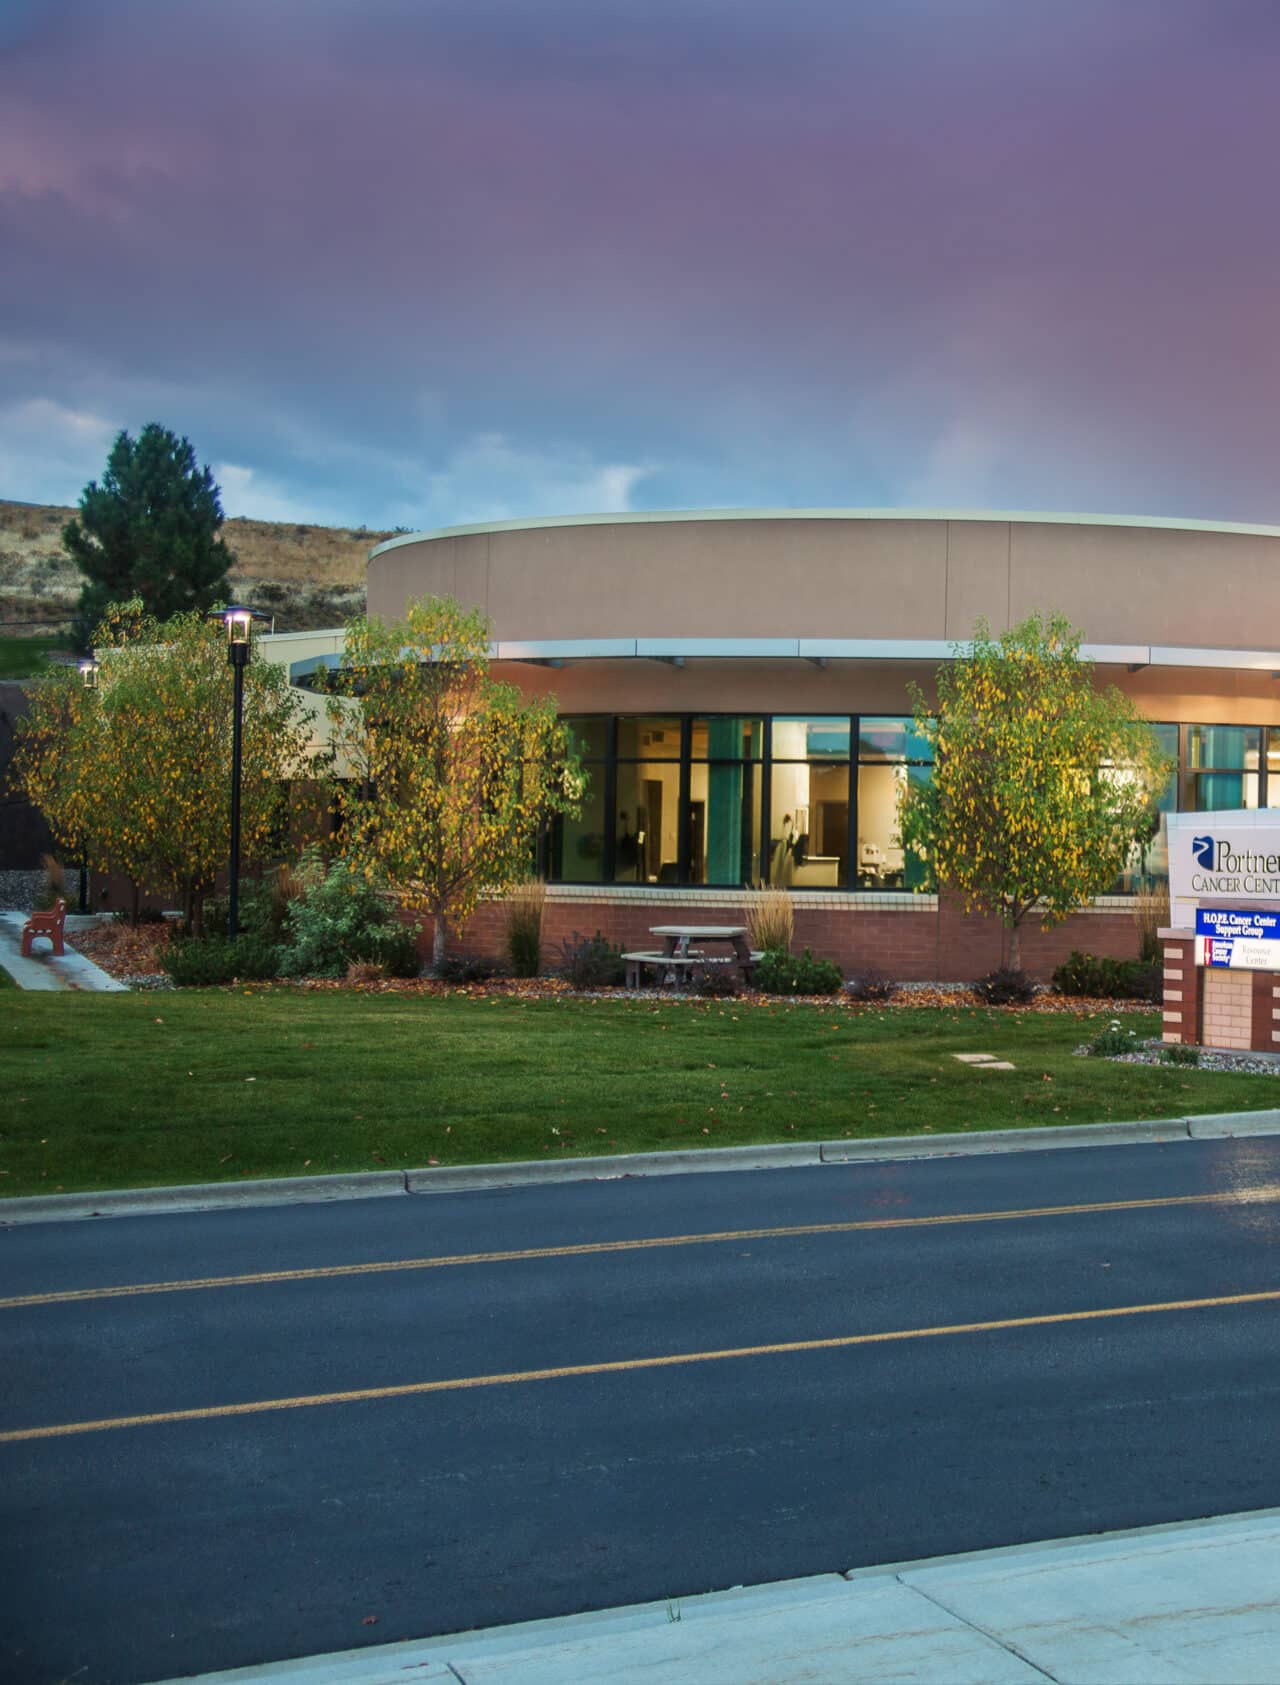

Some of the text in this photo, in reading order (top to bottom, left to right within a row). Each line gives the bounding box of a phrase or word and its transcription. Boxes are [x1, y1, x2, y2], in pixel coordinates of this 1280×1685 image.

[1192, 874, 1240, 892] CANCER
[1229, 914, 1252, 926] Cancer
[1254, 915, 1276, 927] Center
[1215, 924, 1264, 939] Support Group
